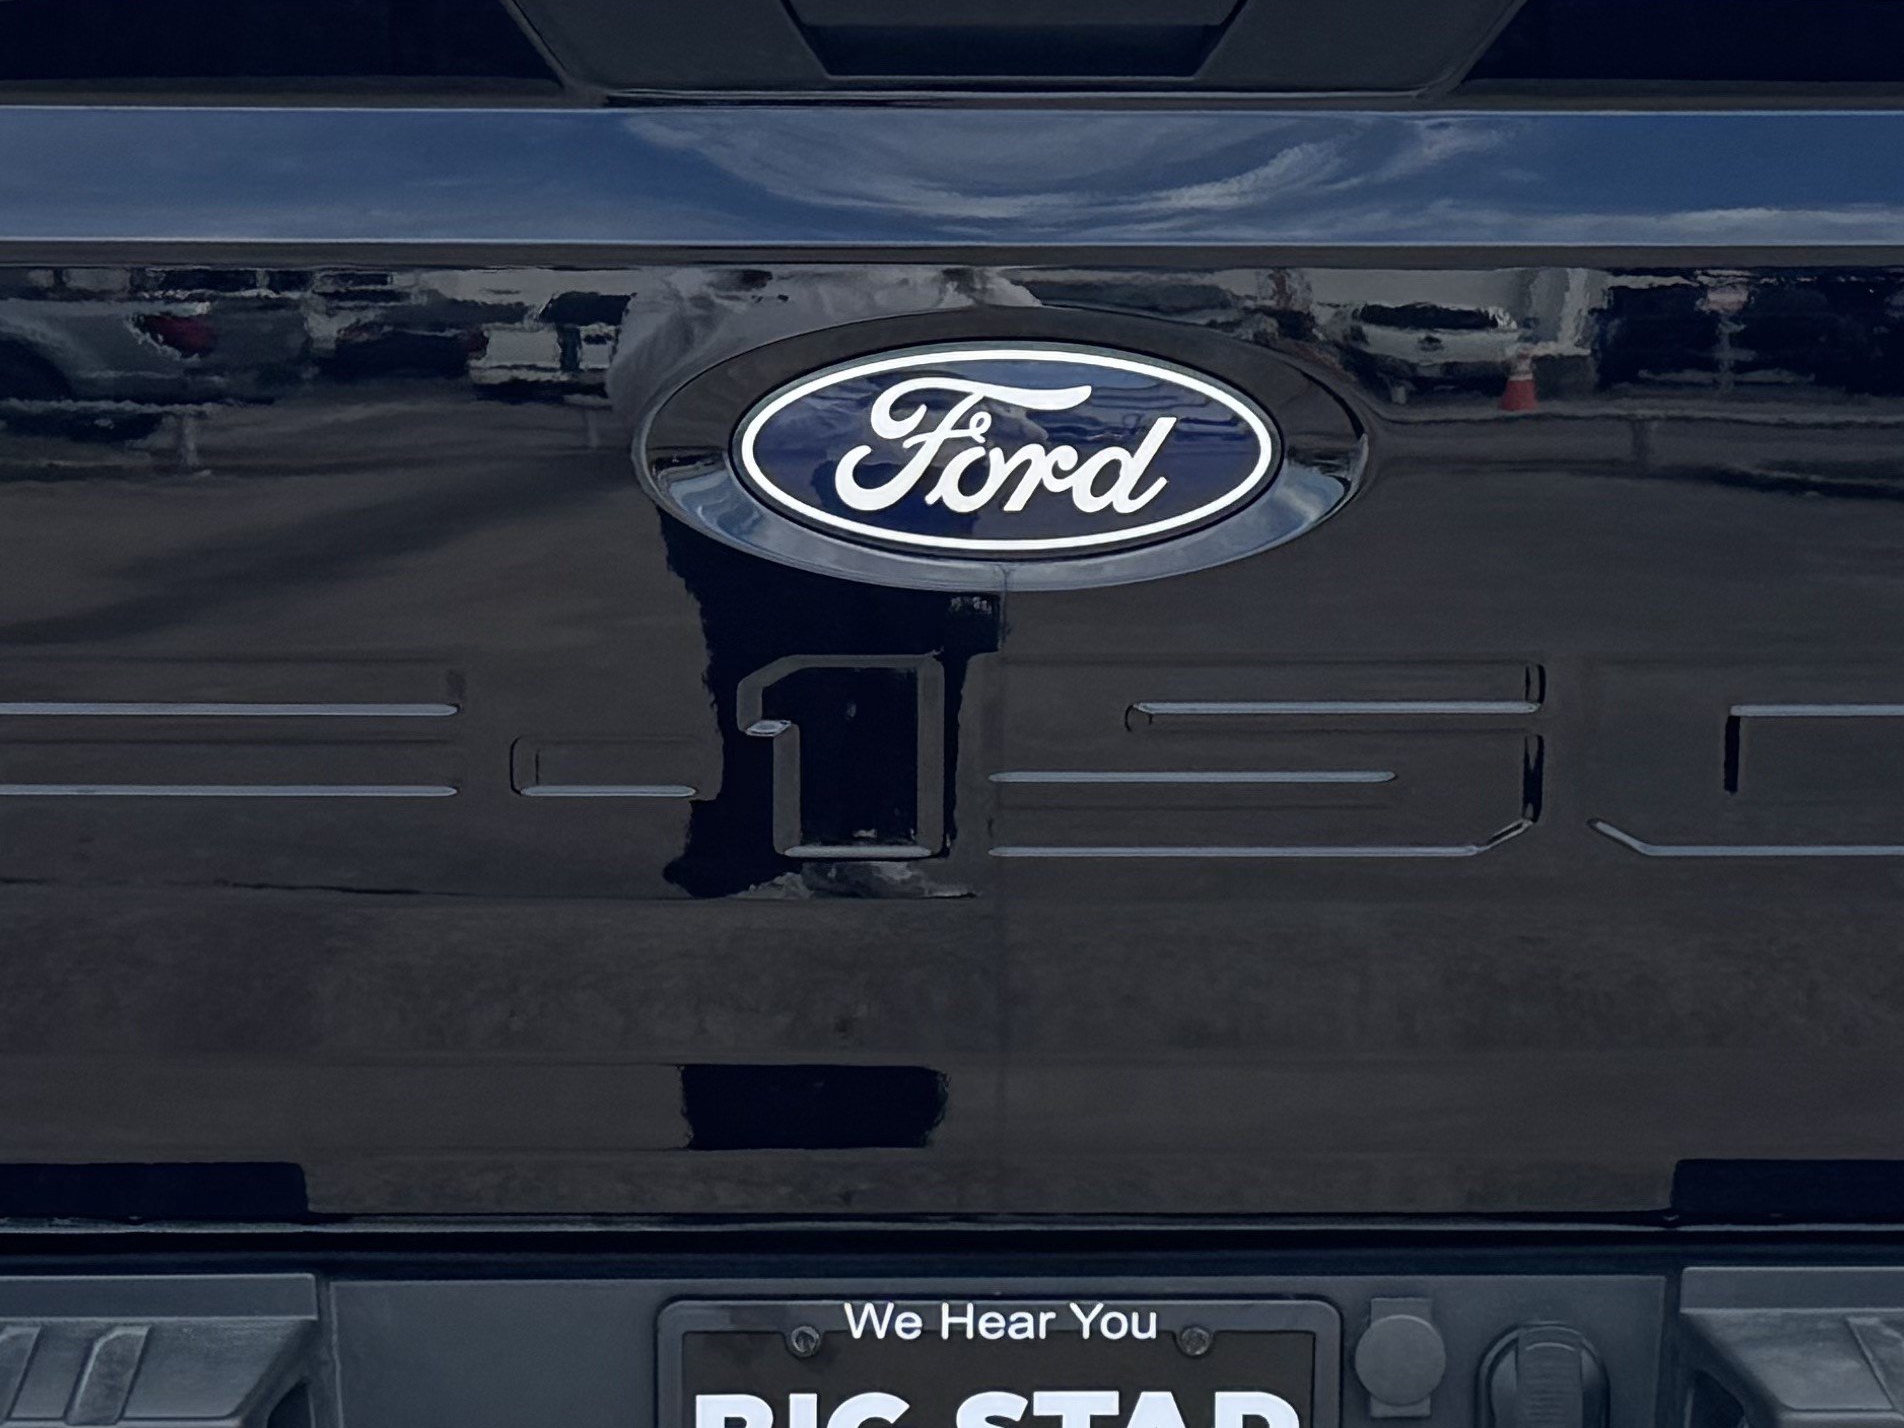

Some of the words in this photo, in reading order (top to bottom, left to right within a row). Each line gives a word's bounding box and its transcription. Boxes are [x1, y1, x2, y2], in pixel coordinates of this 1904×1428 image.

[834, 376, 1178, 514] Ford
[843, 1301, 923, 1340] We
[941, 1301, 1057, 1340] Hear
[1069, 1301, 1157, 1340] You
